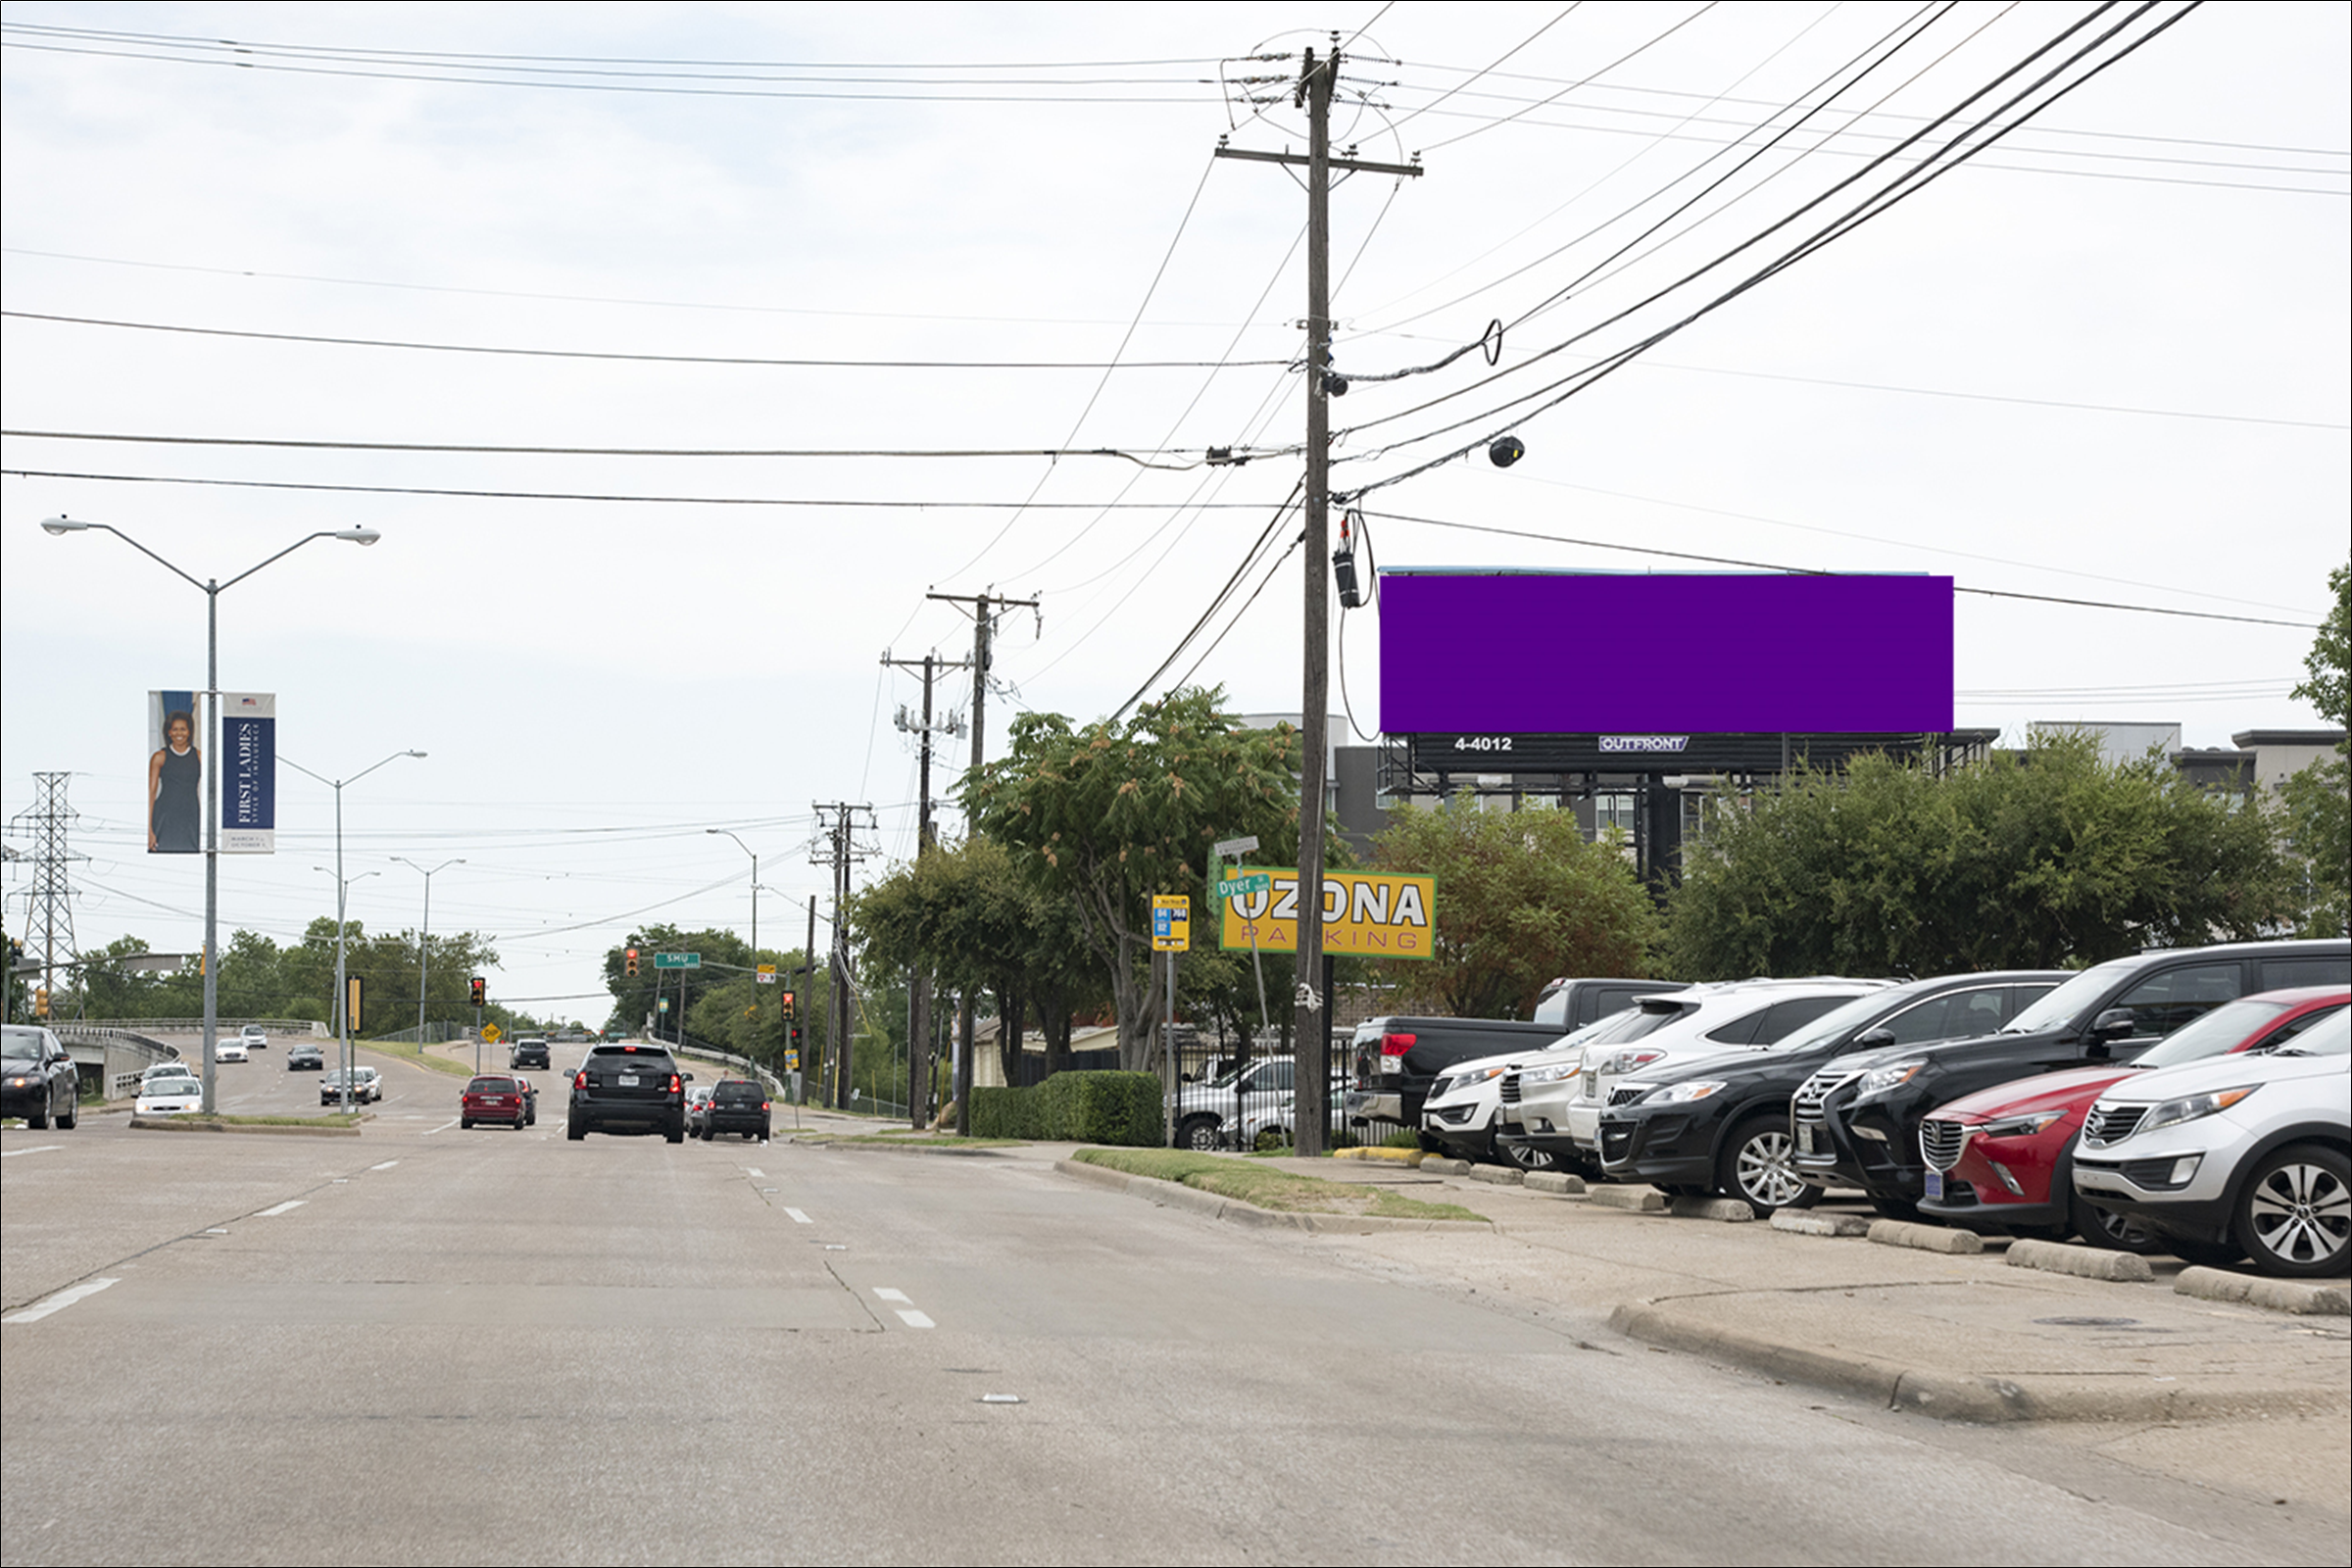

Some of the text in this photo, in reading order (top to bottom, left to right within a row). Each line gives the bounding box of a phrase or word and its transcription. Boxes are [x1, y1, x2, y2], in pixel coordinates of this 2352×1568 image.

[238, 723, 251, 777] LADIES
[1454, 737, 1512, 751] 4-4012
[1601, 737, 1686, 750] OUTFRONT
[252, 780, 259, 792] OF
[238, 780, 251, 823] FIRST
[1219, 879, 1250, 896] Dyer
[1231, 878, 1428, 927] OZONA
[1241, 924, 1417, 950] PAKING
[666, 954, 689, 963] SMU
